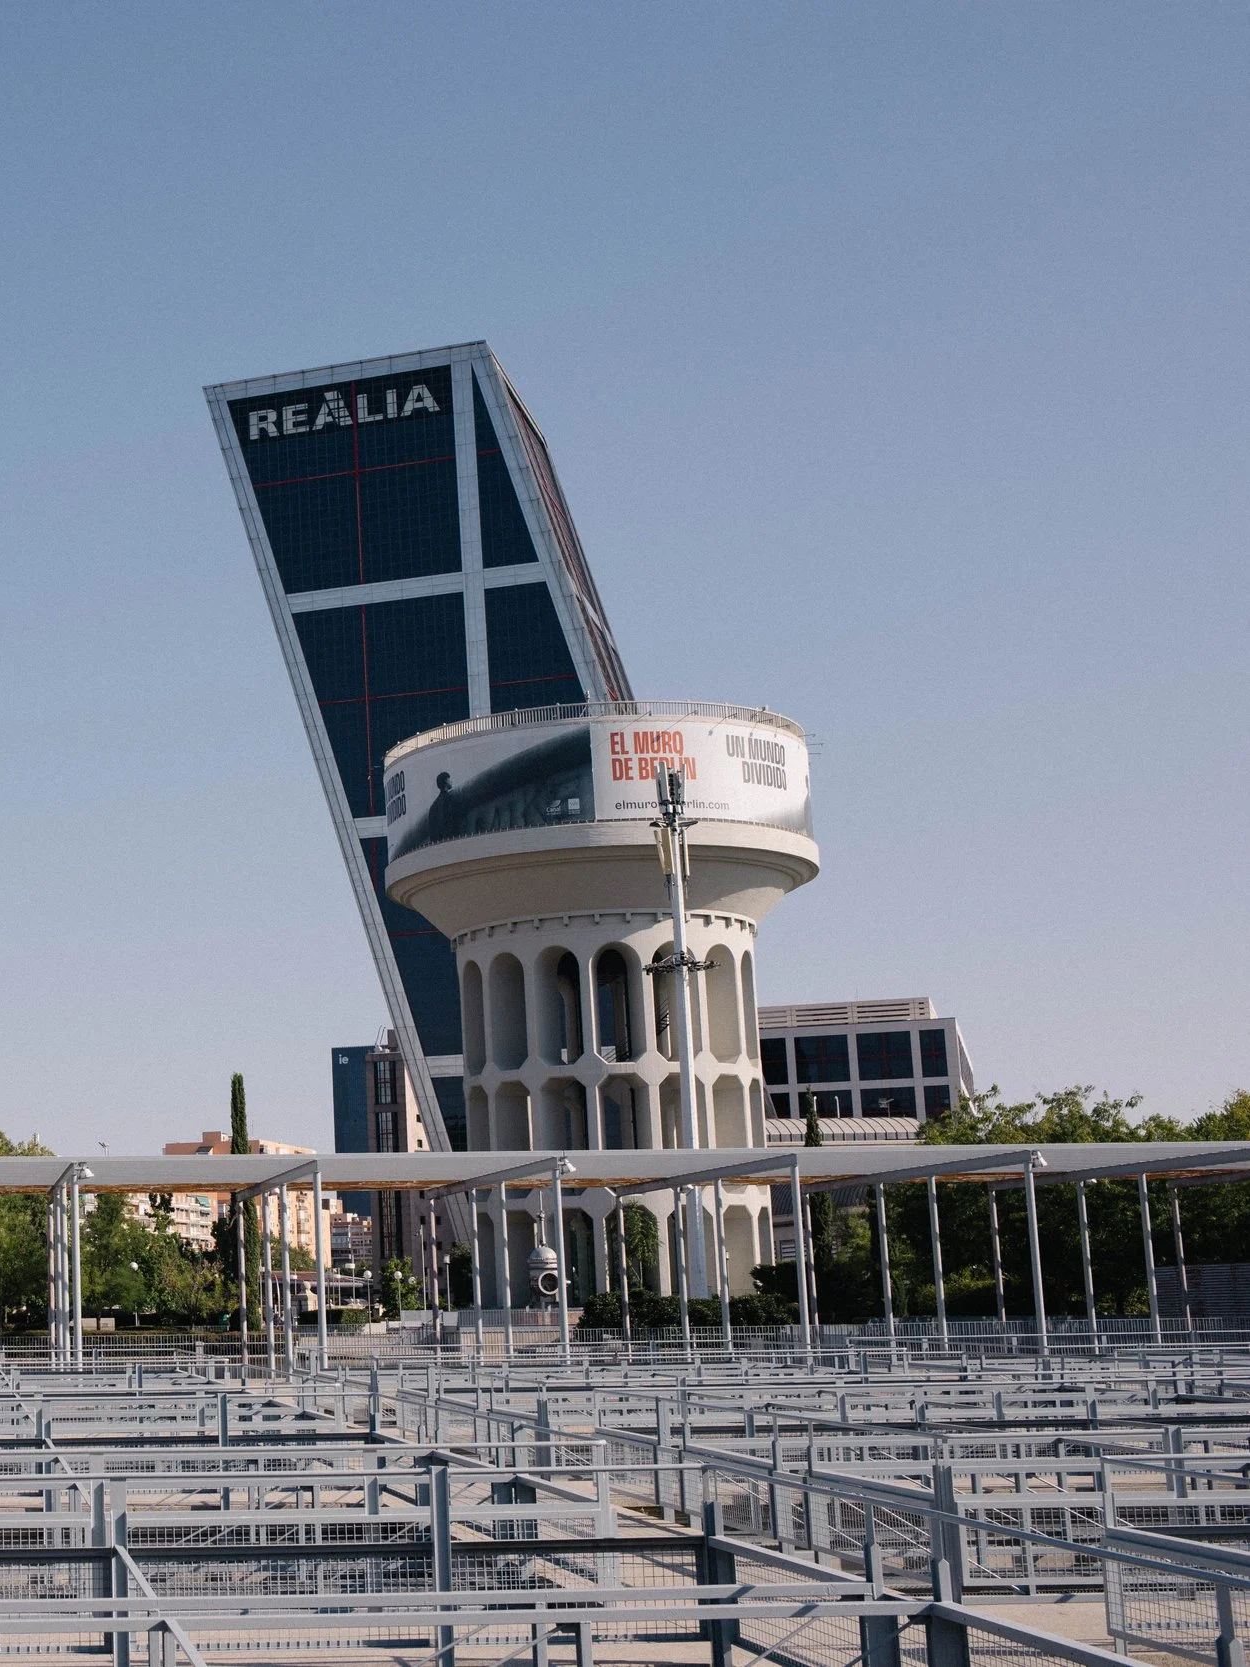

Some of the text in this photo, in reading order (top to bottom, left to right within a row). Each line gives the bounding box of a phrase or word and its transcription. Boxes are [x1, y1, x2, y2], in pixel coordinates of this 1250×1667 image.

[248, 384, 441, 440] REALIA
[610, 731, 684, 755] EL MURO
[726, 734, 786, 767] UN MUNDO
[612, 756, 697, 781] DE BEIN
[742, 761, 787, 790] DIVIDIDO
[615, 799, 730, 811] elmurorlin.com
[339, 1054, 349, 1064] ie
